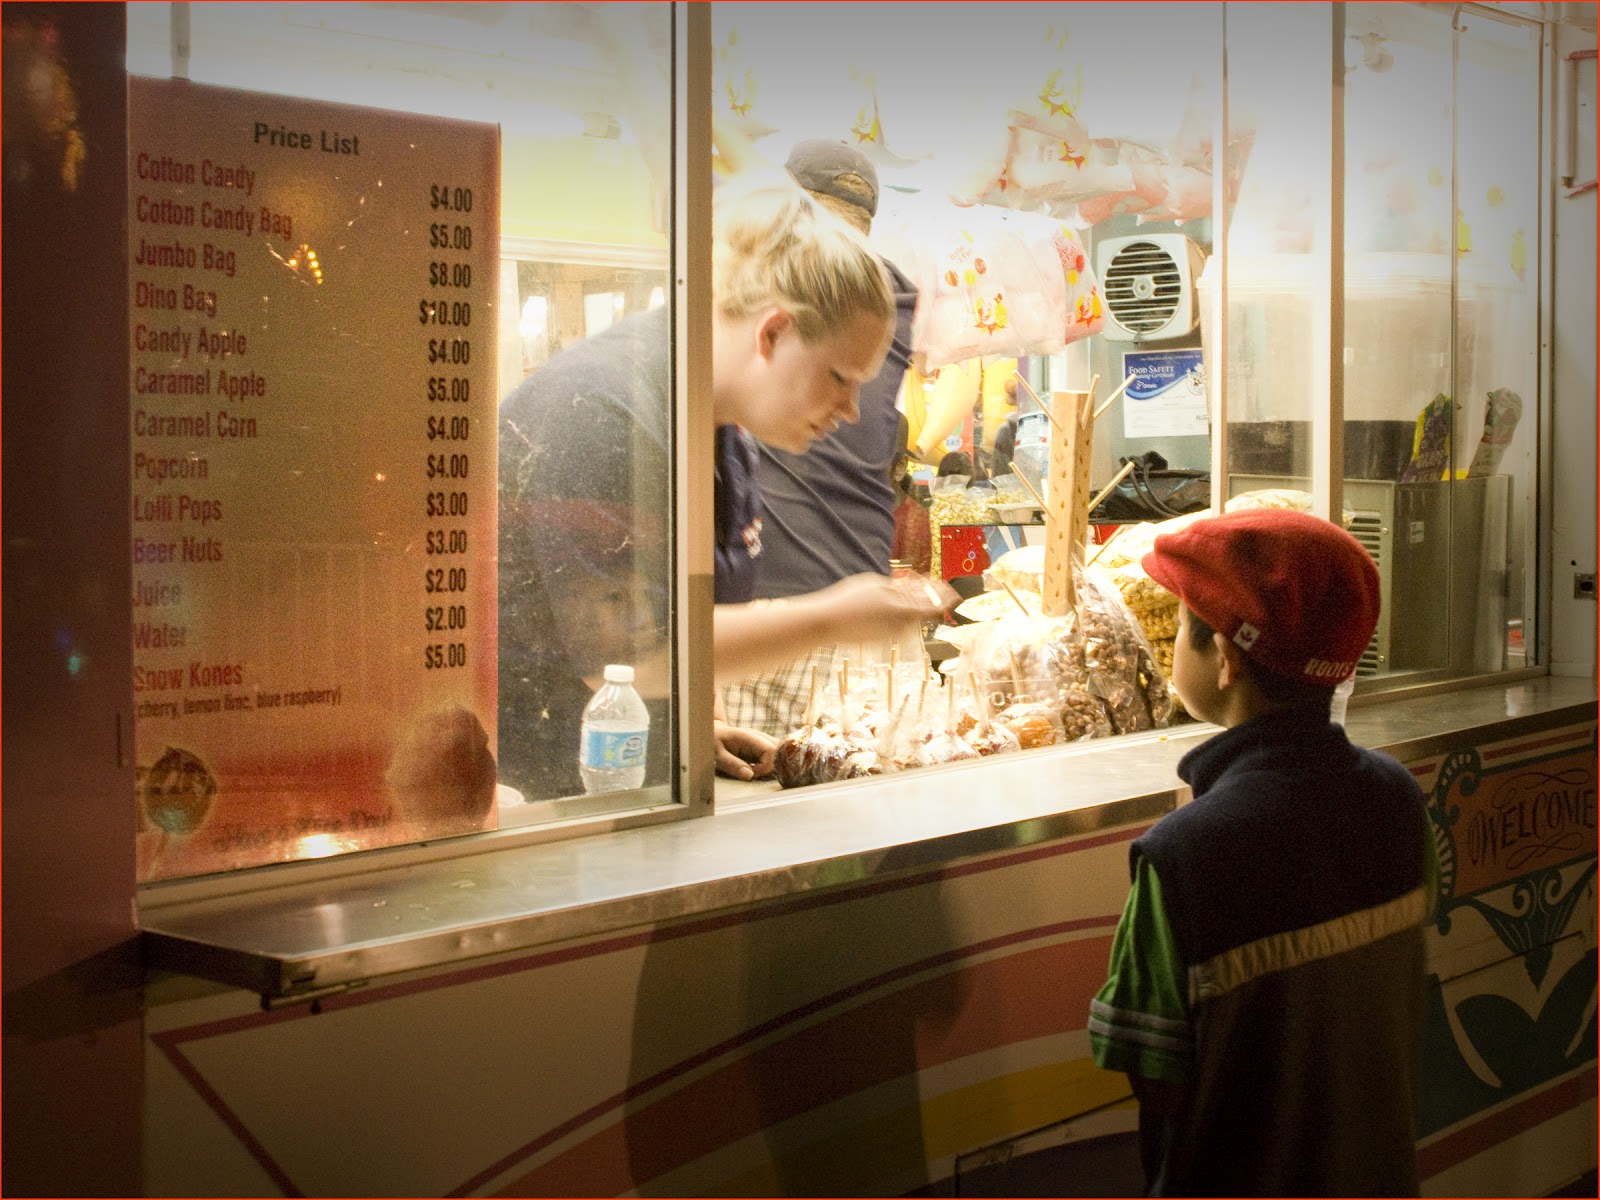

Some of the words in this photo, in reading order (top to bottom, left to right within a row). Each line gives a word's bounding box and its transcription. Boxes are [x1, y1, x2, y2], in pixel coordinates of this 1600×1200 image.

[253, 122, 312, 150] Price
[320, 130, 360, 156] List
[136, 153, 195, 184] Cotton
[200, 160, 255, 195] Candy
[430, 184, 473, 213] $4.00
[135, 195, 195, 226] Cotton
[200, 201, 254, 237] Candy
[260, 207, 293, 241] Bag
[429, 223, 472, 251] $5.00
[135, 239, 196, 268] Jumbo
[203, 243, 236, 277] Bag
[429, 262, 471, 288] $8.00
[135, 281, 178, 309] Dino
[182, 285, 217, 317] Bag
[419, 300, 471, 327] $10.00
[135, 324, 190, 358] Candy
[199, 329, 247, 358] Apple
[428, 339, 470, 365] $4.00
[1129, 366, 1147, 374] FOOD
[1149, 365, 1175, 373] SAFETY
[134, 367, 210, 396] Caramel
[217, 370, 265, 400] Apple
[427, 377, 470, 403] $5.00
[134, 409, 210, 438] Caramel
[217, 411, 257, 438] Corn
[427, 416, 469, 442] $4.00
[134, 452, 209, 485] Popcorn
[427, 453, 469, 479] $4.00
[134, 495, 172, 522] Lolli
[178, 496, 223, 528] Pops
[426, 492, 468, 517] $3.00
[134, 539, 176, 564] Beer
[182, 538, 223, 563] Nuts
[426, 530, 467, 555] $3.00
[134, 580, 181, 605] Juice
[425, 567, 466, 594] $2.00
[425, 606, 466, 632] $2.00
[134, 624, 187, 649] Water
[425, 643, 466, 669] $5.00
[134, 665, 183, 692] Snow
[189, 662, 243, 687] Kones
[257, 689, 282, 709] blue
[284, 685, 342, 710] raspberry)
[1467, 789, 1595, 866] WELCOME
